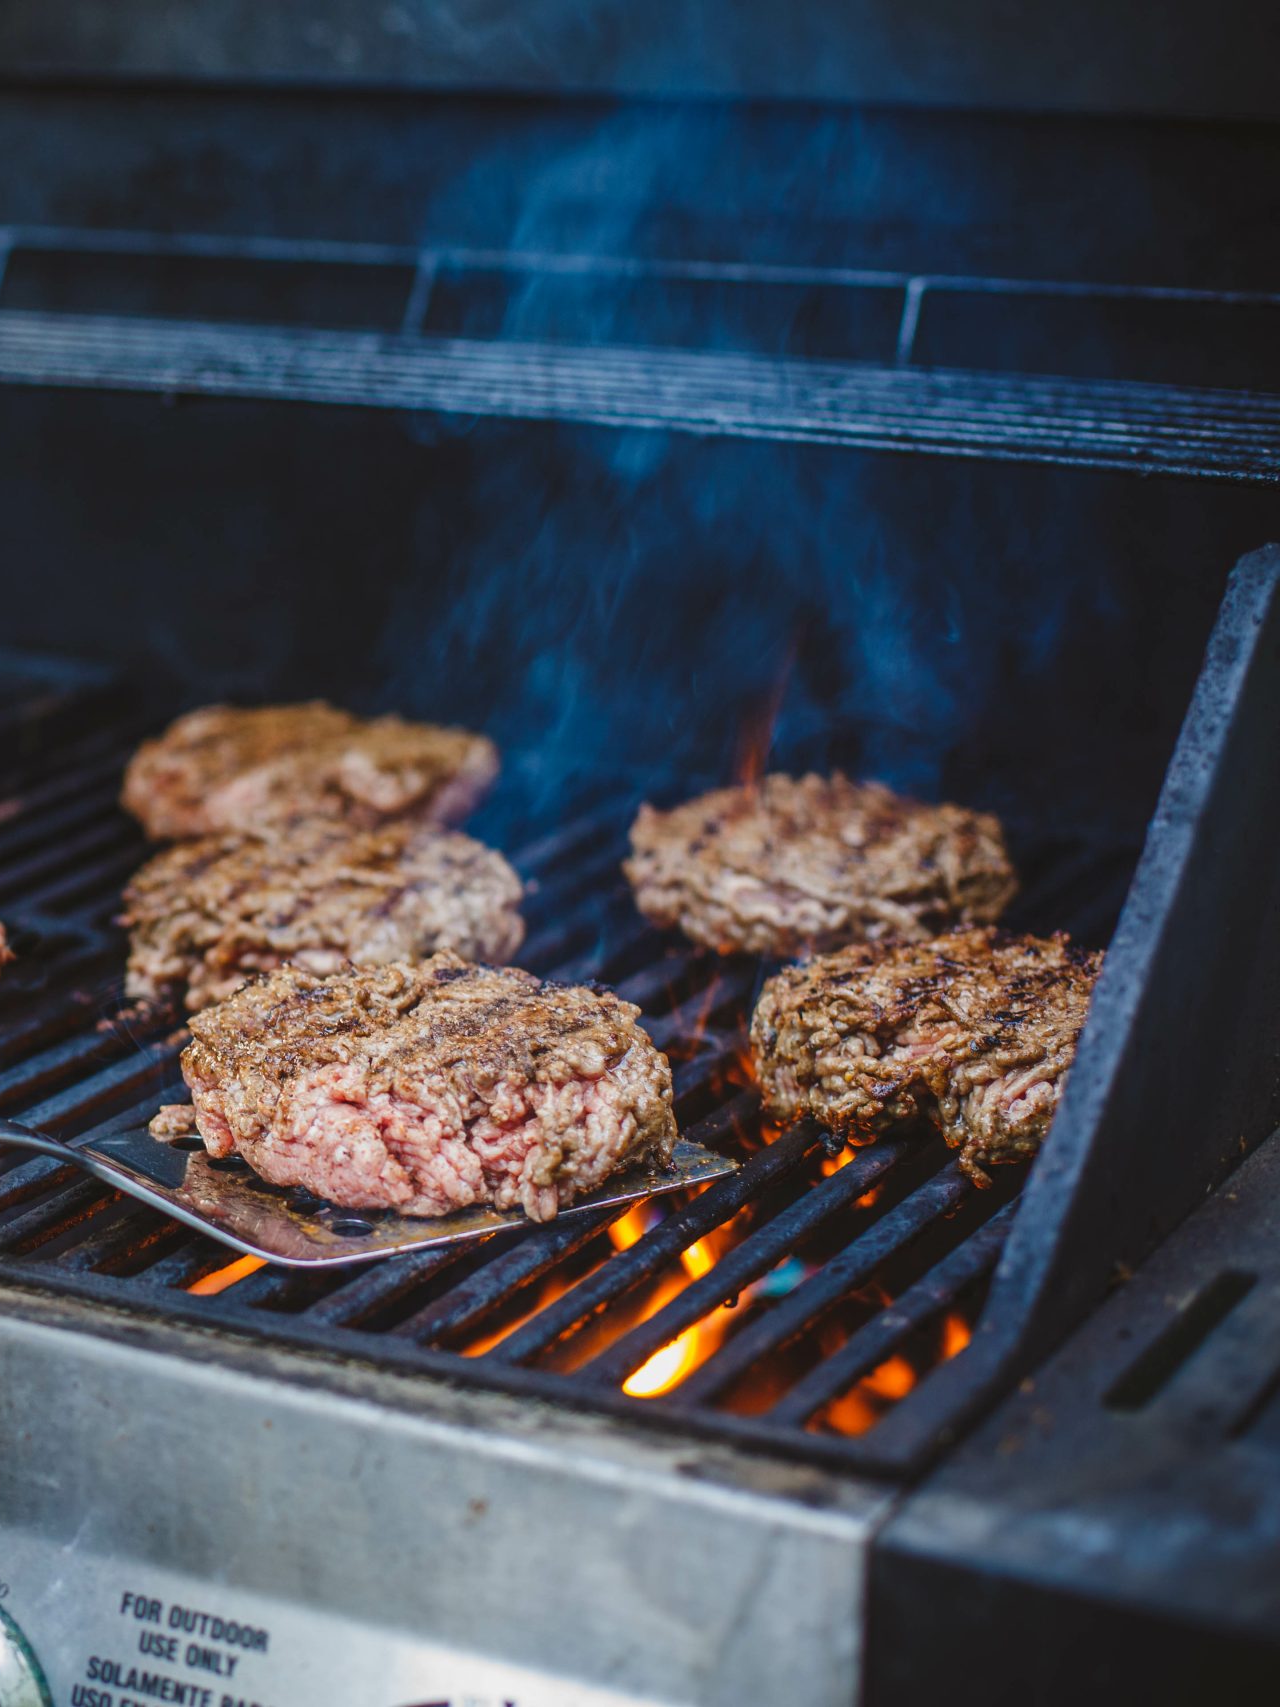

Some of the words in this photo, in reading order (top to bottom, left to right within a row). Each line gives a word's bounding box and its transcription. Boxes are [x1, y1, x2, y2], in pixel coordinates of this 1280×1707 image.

[120, 1591, 162, 1624] FOR
[168, 1605, 269, 1652] OUTDOOR
[138, 1630, 178, 1661] USE
[185, 1643, 238, 1677] ONLY
[72, 1683, 112, 1707] USO
[86, 1655, 212, 1707] SOLAMENTE
